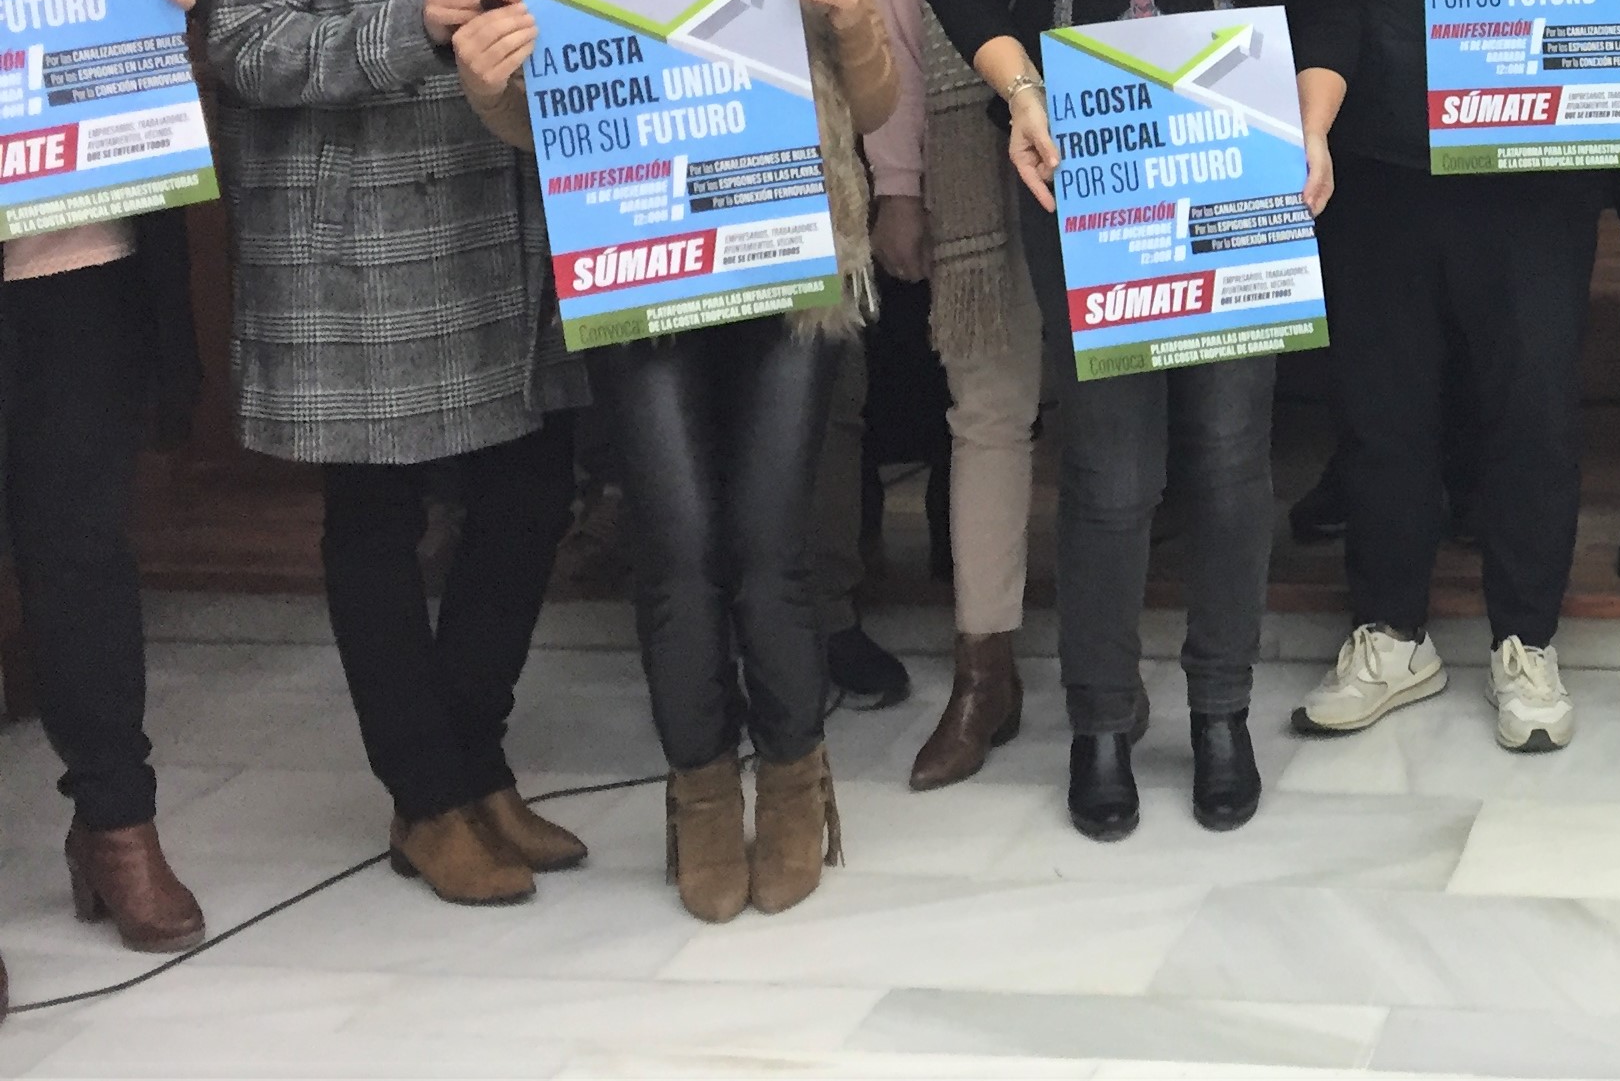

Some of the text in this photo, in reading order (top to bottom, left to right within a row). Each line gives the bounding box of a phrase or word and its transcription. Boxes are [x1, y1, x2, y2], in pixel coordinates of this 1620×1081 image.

[529, 35, 642, 76] LA COSTA
[534, 58, 752, 118] TROPICAL UNIDA
[1052, 83, 1151, 119] LA COSTA
[1442, 90, 1550, 124] SÚMATE
[542, 100, 745, 159] POR SU FUTURO
[1055, 107, 1248, 159] TROPICAL UNIDA
[1061, 147, 1242, 199] POR SU FUTURO
[572, 238, 703, 290] SÚMATE
[1085, 278, 1203, 324] SÚMATE
